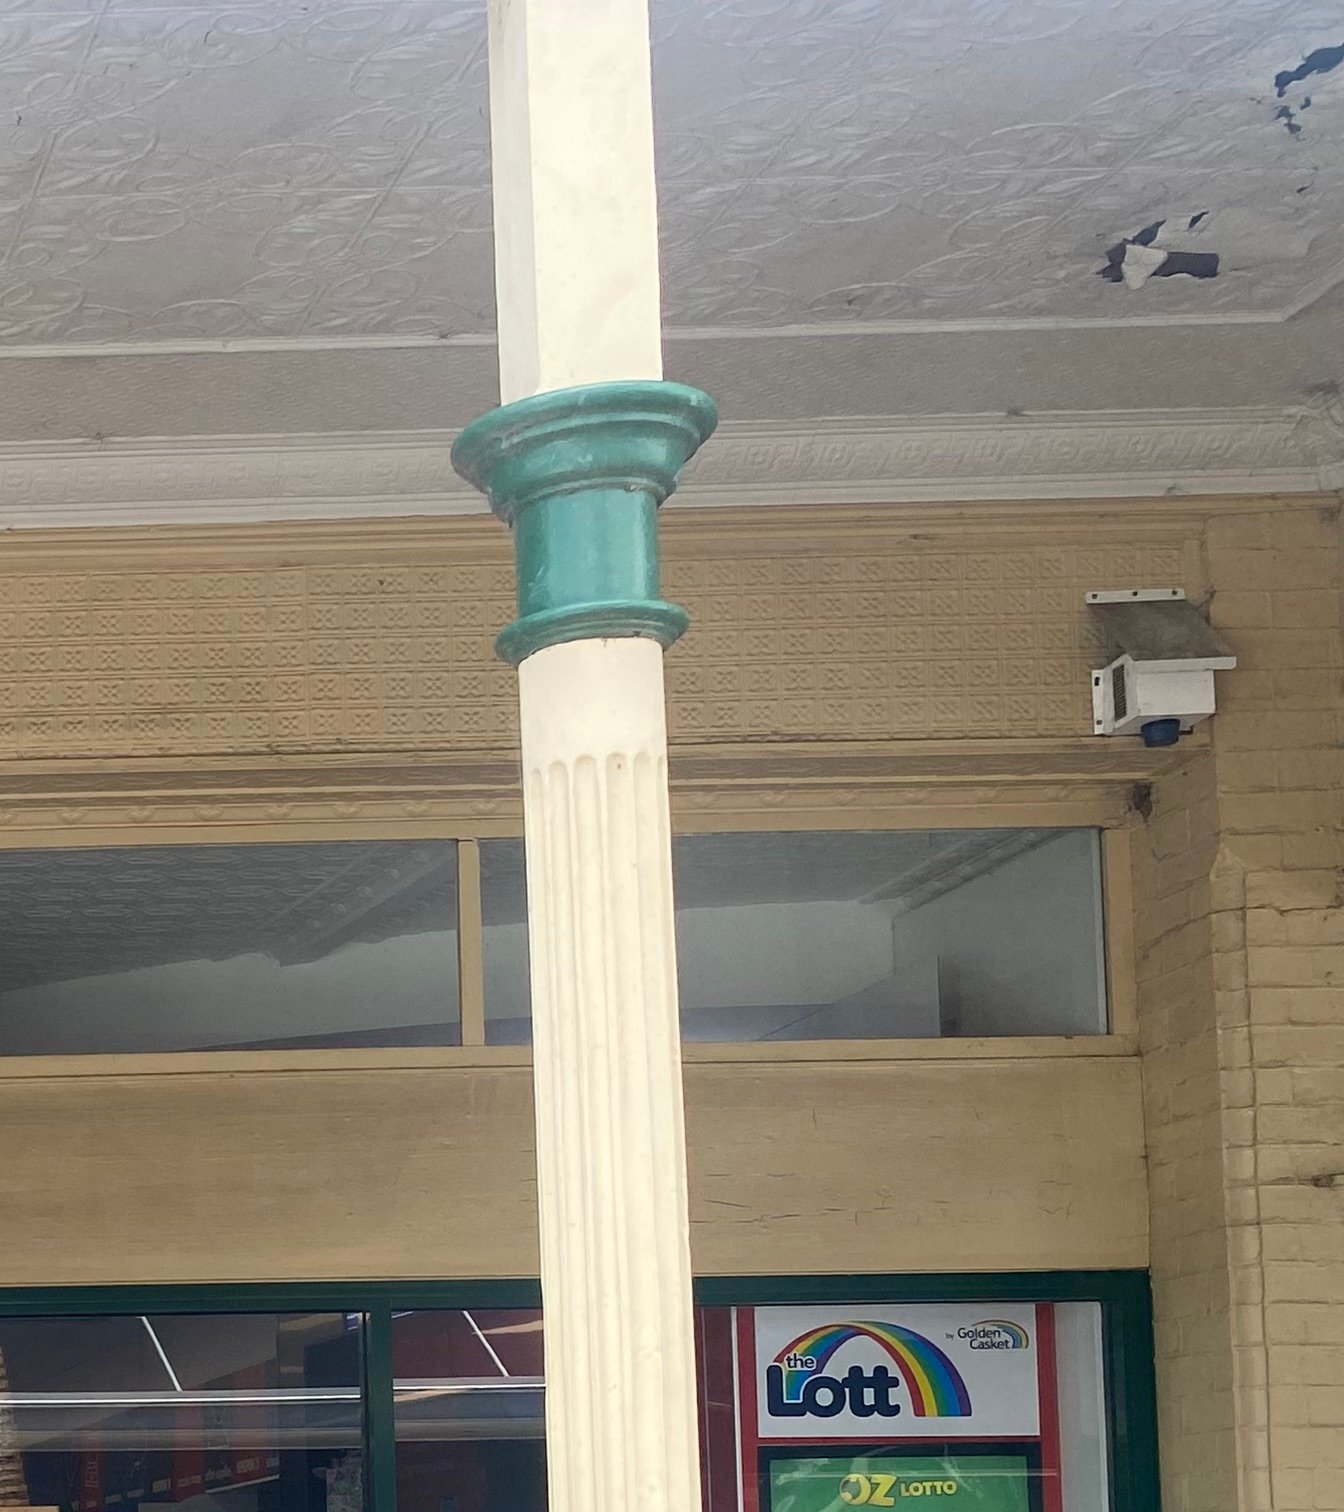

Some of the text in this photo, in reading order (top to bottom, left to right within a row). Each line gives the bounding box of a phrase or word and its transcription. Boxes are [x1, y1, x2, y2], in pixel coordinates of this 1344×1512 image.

[958, 1327, 1001, 1340] Golden
[969, 1338, 1011, 1350] Casket
[786, 1353, 815, 1369] the
[766, 1365, 900, 1417] Lott
[839, 1473, 958, 1507] OZ LOTTO
